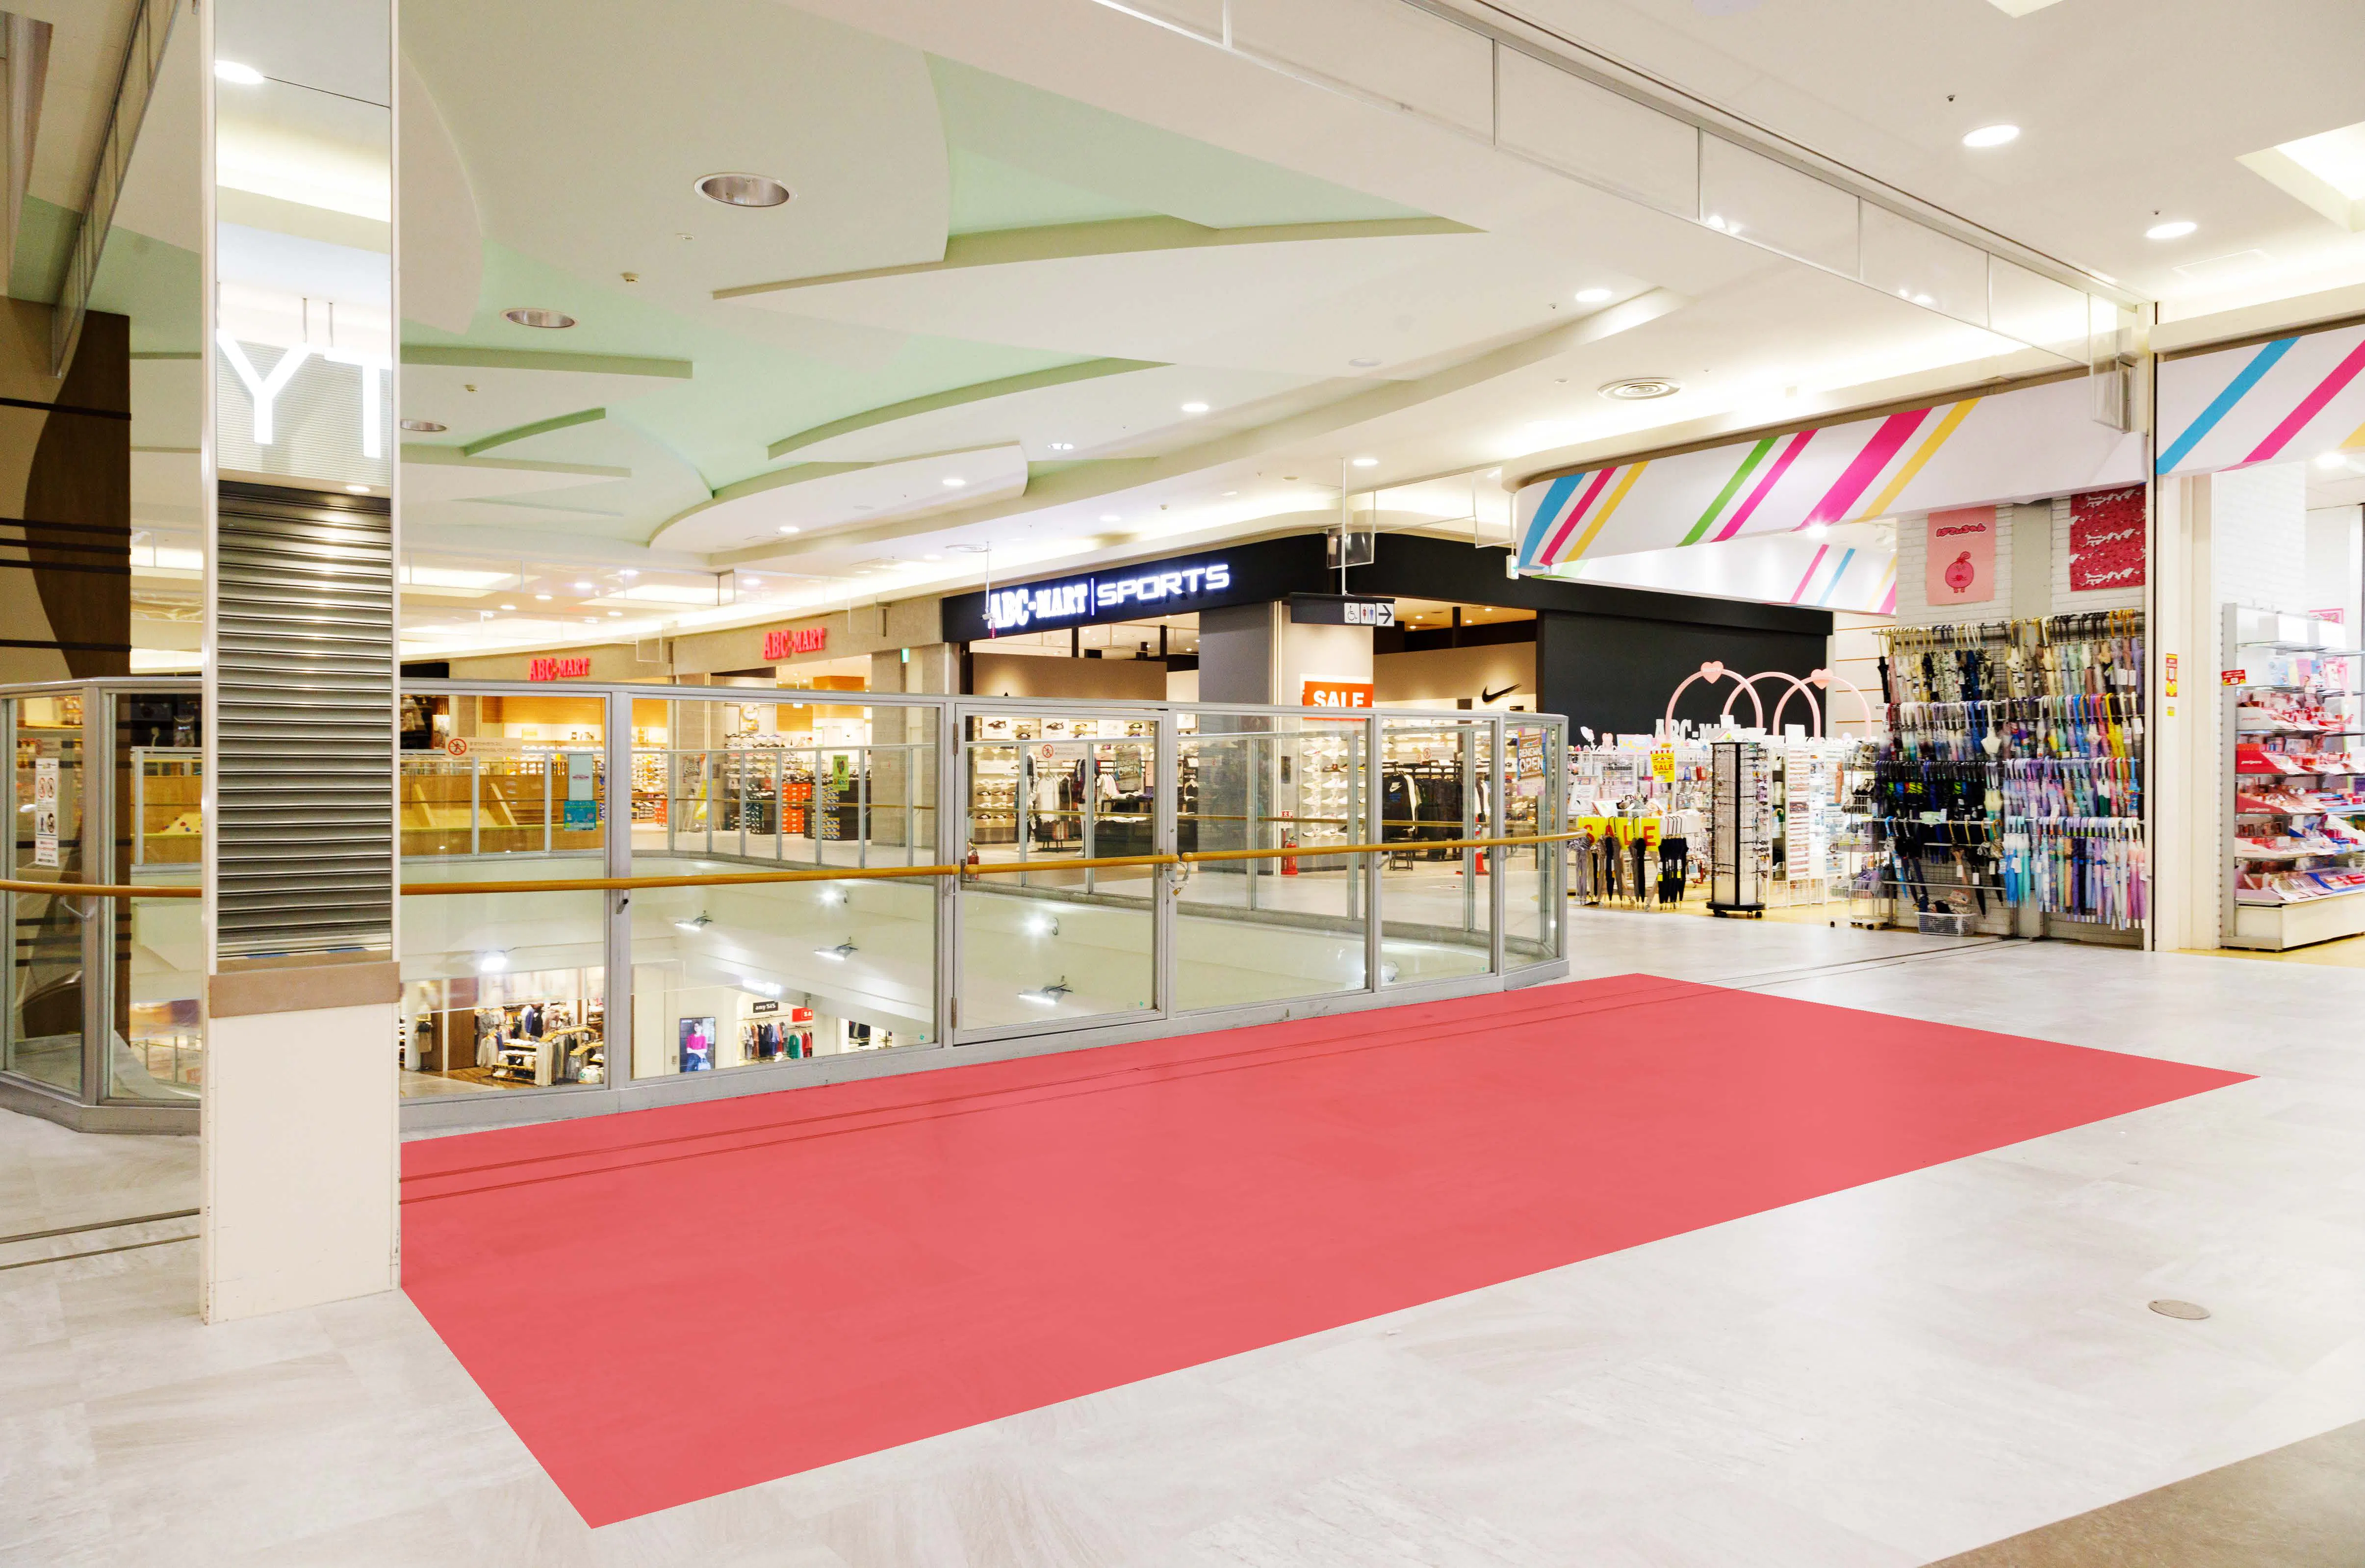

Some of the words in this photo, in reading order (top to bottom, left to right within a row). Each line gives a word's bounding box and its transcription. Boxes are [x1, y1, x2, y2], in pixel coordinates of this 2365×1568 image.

[988, 583, 1088, 629] ABC-MART
[1098, 564, 1230, 606] SPORTS
[763, 627, 825, 659] ABC-MART
[529, 657, 591, 681] ABC-MART
[1519, 756, 1543, 773] OPEN
[1583, 824, 1657, 846] SALE
